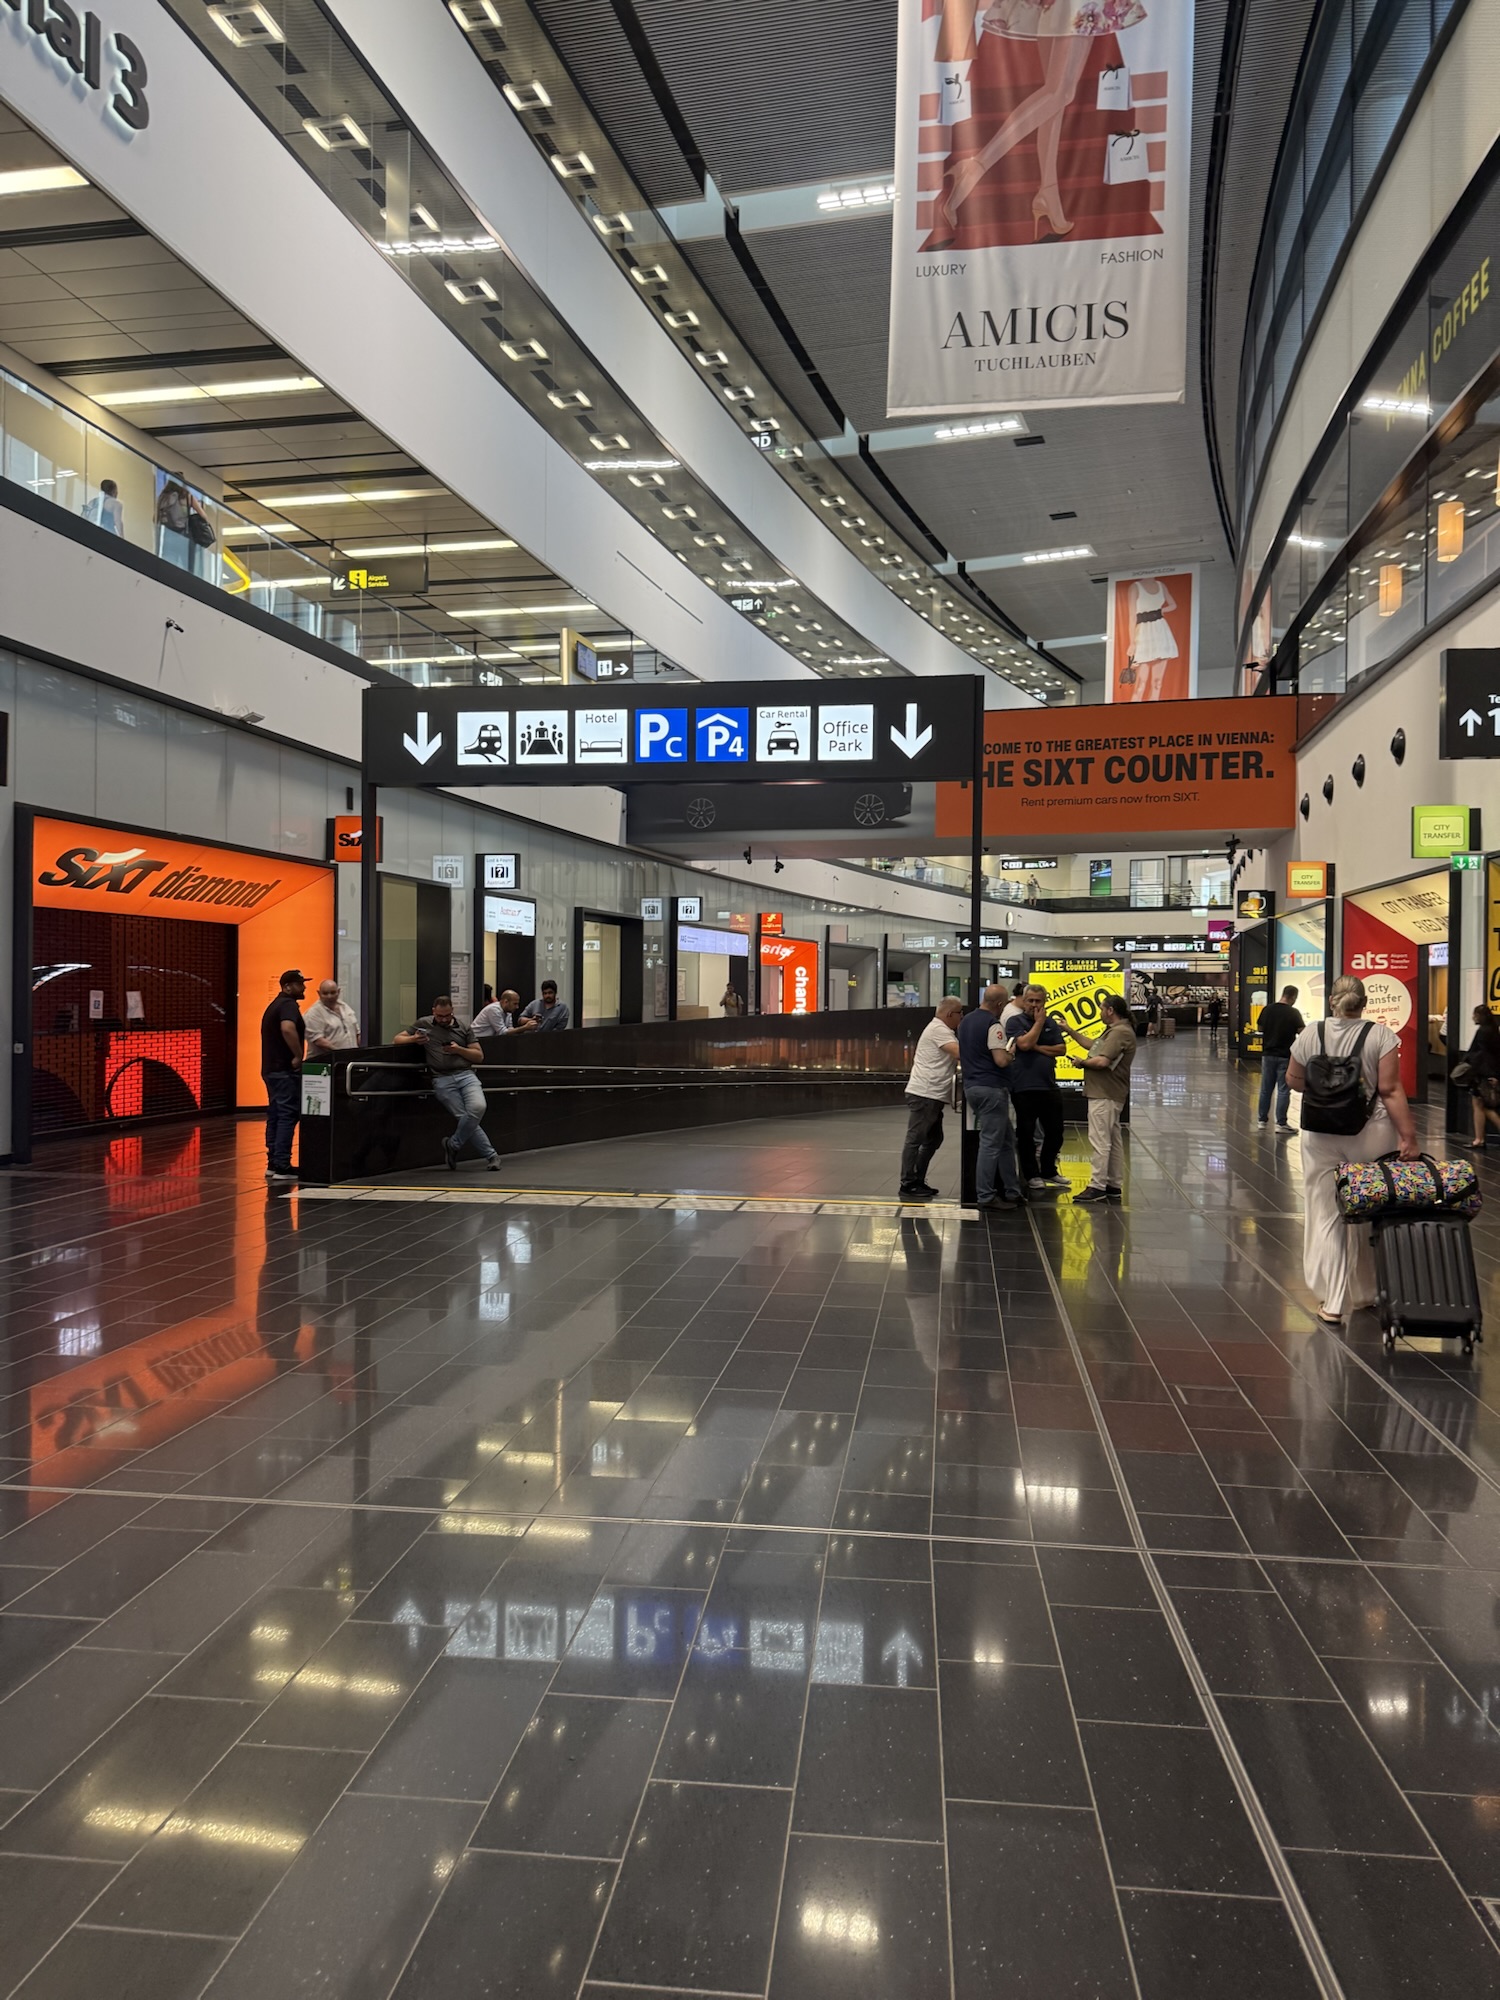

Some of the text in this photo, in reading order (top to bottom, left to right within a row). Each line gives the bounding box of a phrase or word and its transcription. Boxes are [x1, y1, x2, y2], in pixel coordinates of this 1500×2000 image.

[113, 33, 149, 130] 3
[1101, 249, 1164, 264] FASHION
[916, 264, 967, 278] LUXURY
[1433, 256, 1490, 363] COFFEE
[940, 300, 1130, 350] AMICIS
[975, 352, 1097, 372] TUCHLAUBEN
[585, 713, 617, 724] Hotel
[759, 709, 808, 719] Car Rental
[823, 722, 869, 736] Office
[708, 726, 744, 757] P4
[829, 740, 862, 753] Park
[984, 731, 1275, 755] COME TO THE GREATEST PLACE IN VIENNA:
[1023, 757, 1095, 787] SIXT
[1104, 751, 1274, 785] COUNTER.
[1021, 792, 1200, 808] Rent premium cars now from SIXT.
[1423, 832, 1461, 840] TRANSFER
[149, 865, 282, 909] diamond
[1381, 891, 1449, 914] CITY TRANSFER
[1412, 918, 1442, 933] FIXED
[1035, 960, 1064, 972] HERE
[1130, 962, 1189, 970] TARBUCKS COFFEE
[1280, 951, 1322, 968] 31300
[1351, 951, 1389, 970] ats
[790, 966, 810, 1015] chang
[1046, 974, 1096, 1002] RANSFER
[1368, 984, 1390, 994] City
[1369, 994, 1403, 1005] ansfer
[1381, 1006, 1400, 1015] price!
